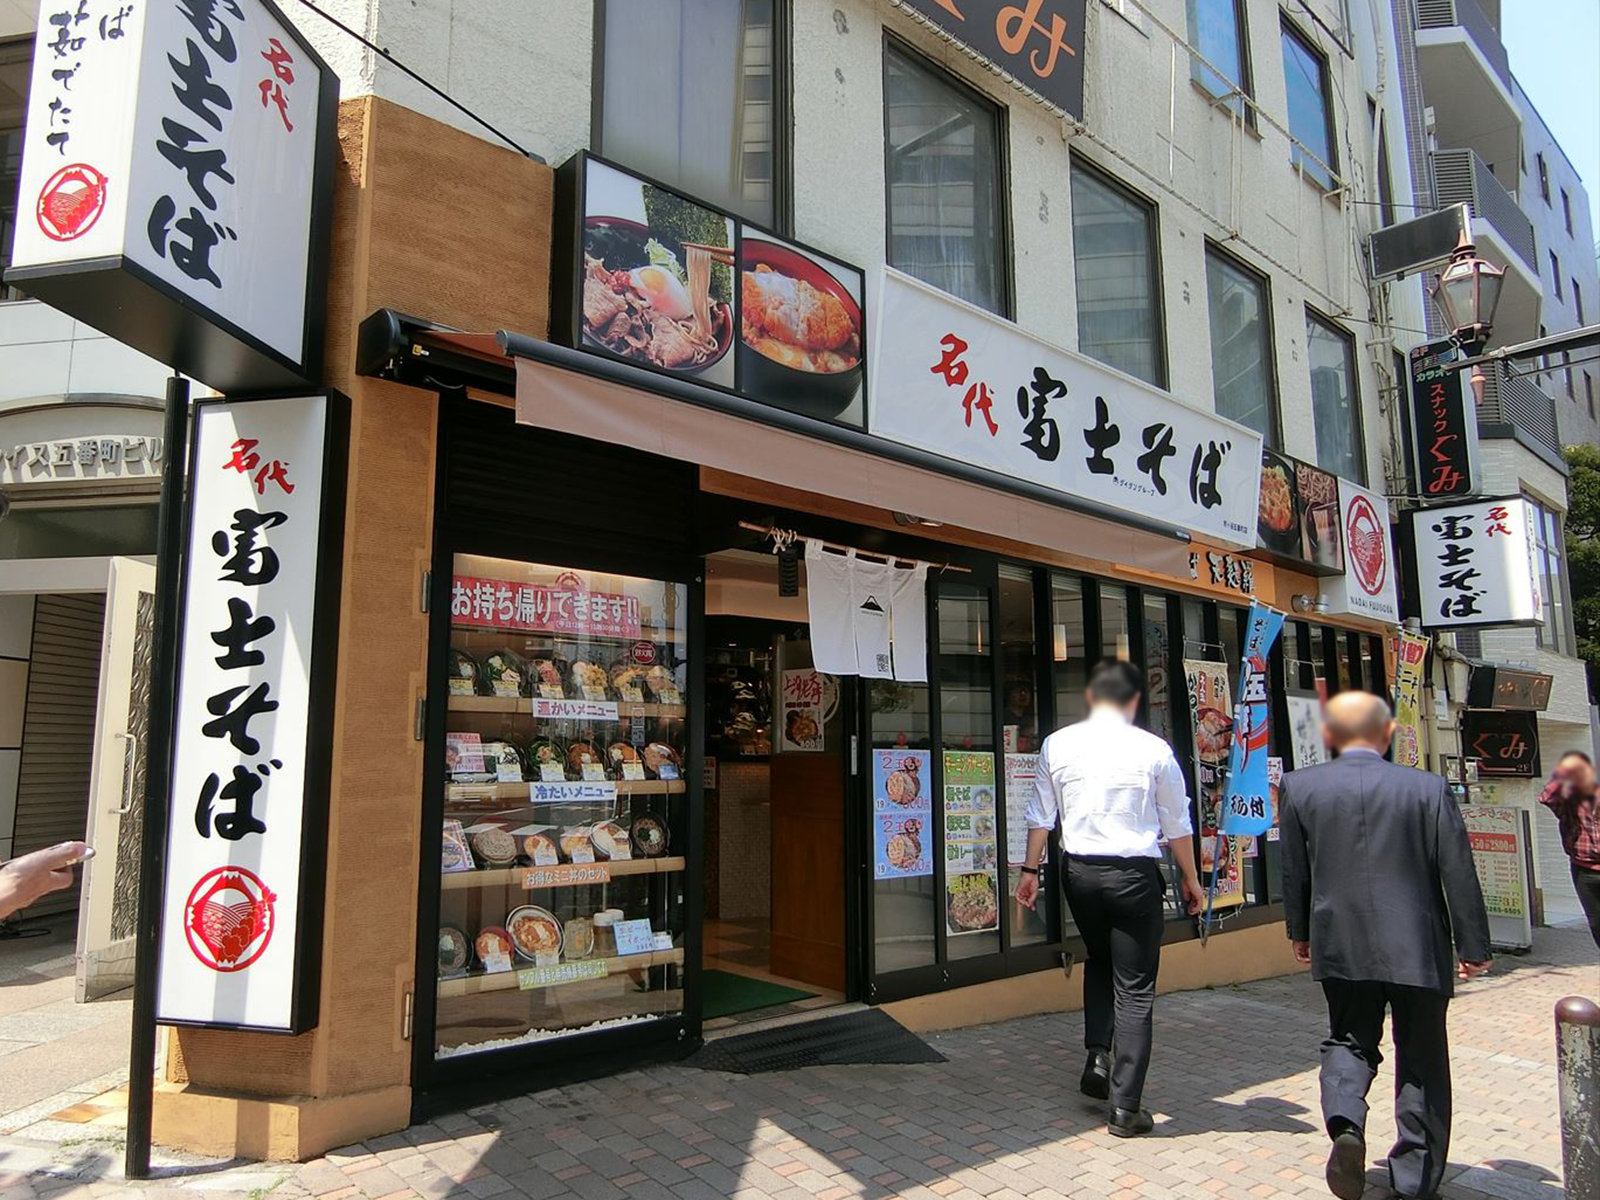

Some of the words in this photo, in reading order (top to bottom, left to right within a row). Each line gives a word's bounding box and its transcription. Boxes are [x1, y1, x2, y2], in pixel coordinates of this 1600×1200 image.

[930, 0, 1076, 78] み
[259, 37, 293, 132] 名代
[148, 0, 246, 288] 富士そば
[929, 332, 998, 437] 名代
[1430, 383, 1448, 433] スナック
[0, 437, 163, 470] イス五番町ビル
[222, 438, 296, 496] 名代
[1016, 365, 1232, 510] 富士そば
[1427, 433, 1465, 494] くみ
[1483, 505, 1513, 538] 名代
[1431, 514, 1488, 619] 富士そば
[194, 507, 289, 842] 富士そば
[537, 701, 617, 717] 温かいメニュー
[1472, 732, 1529, 760] くみ
[535, 785, 615, 800] 冷たいメニュー
